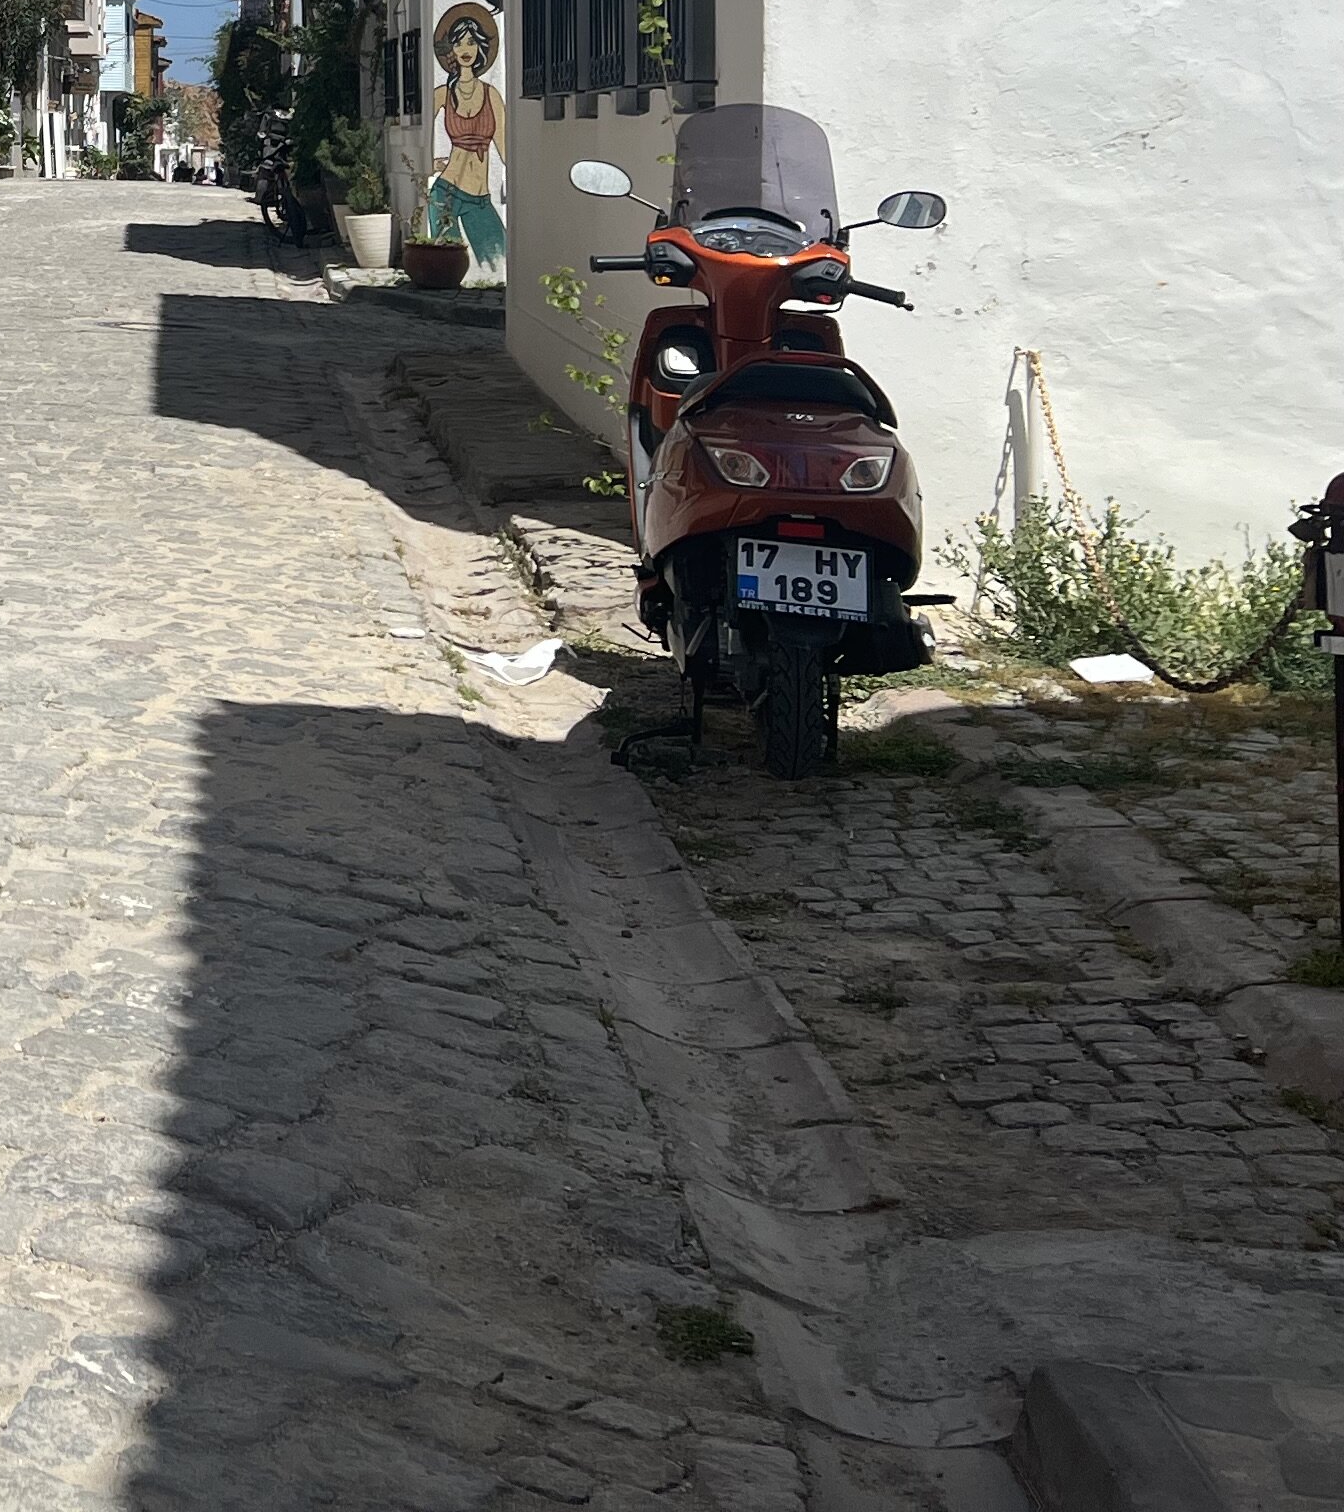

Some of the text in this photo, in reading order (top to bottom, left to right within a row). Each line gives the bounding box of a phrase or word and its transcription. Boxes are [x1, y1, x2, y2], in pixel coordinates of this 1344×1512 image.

[741, 541, 863, 579] 17 HY
[739, 588, 756, 599] TR
[774, 574, 839, 606] 189
[775, 603, 831, 618] EKER
